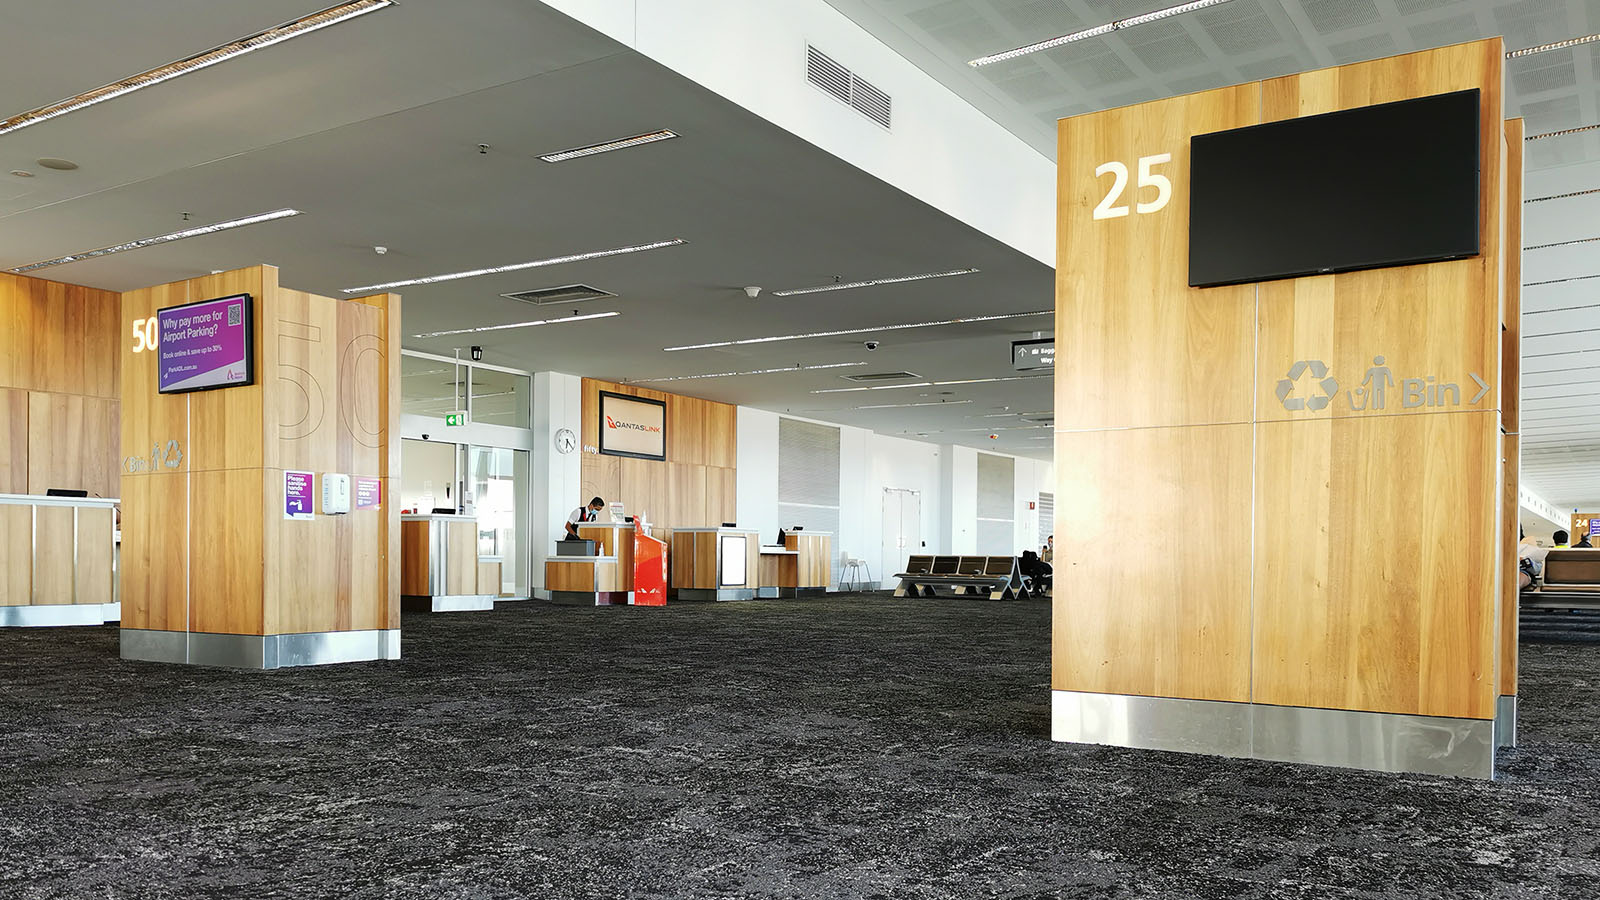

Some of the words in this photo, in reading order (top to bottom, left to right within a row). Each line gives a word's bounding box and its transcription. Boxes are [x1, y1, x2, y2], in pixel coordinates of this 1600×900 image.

[1092, 153, 1173, 222] 25
[162, 318, 178, 330] Why
[178, 317, 192, 329] pay
[192, 313, 212, 325] more
[212, 310, 224, 321] for
[132, 316, 158, 353] 50
[163, 330, 187, 343] Airport
[187, 323, 218, 338] Parking?
[174, 350, 187, 358] online
[201, 347, 207, 355] up
[1402, 375, 1460, 409] Bin
[615, 421, 661, 433] QANTASLINK
[129, 455, 145, 473] Bin
[1575, 519, 1588, 528] 24
